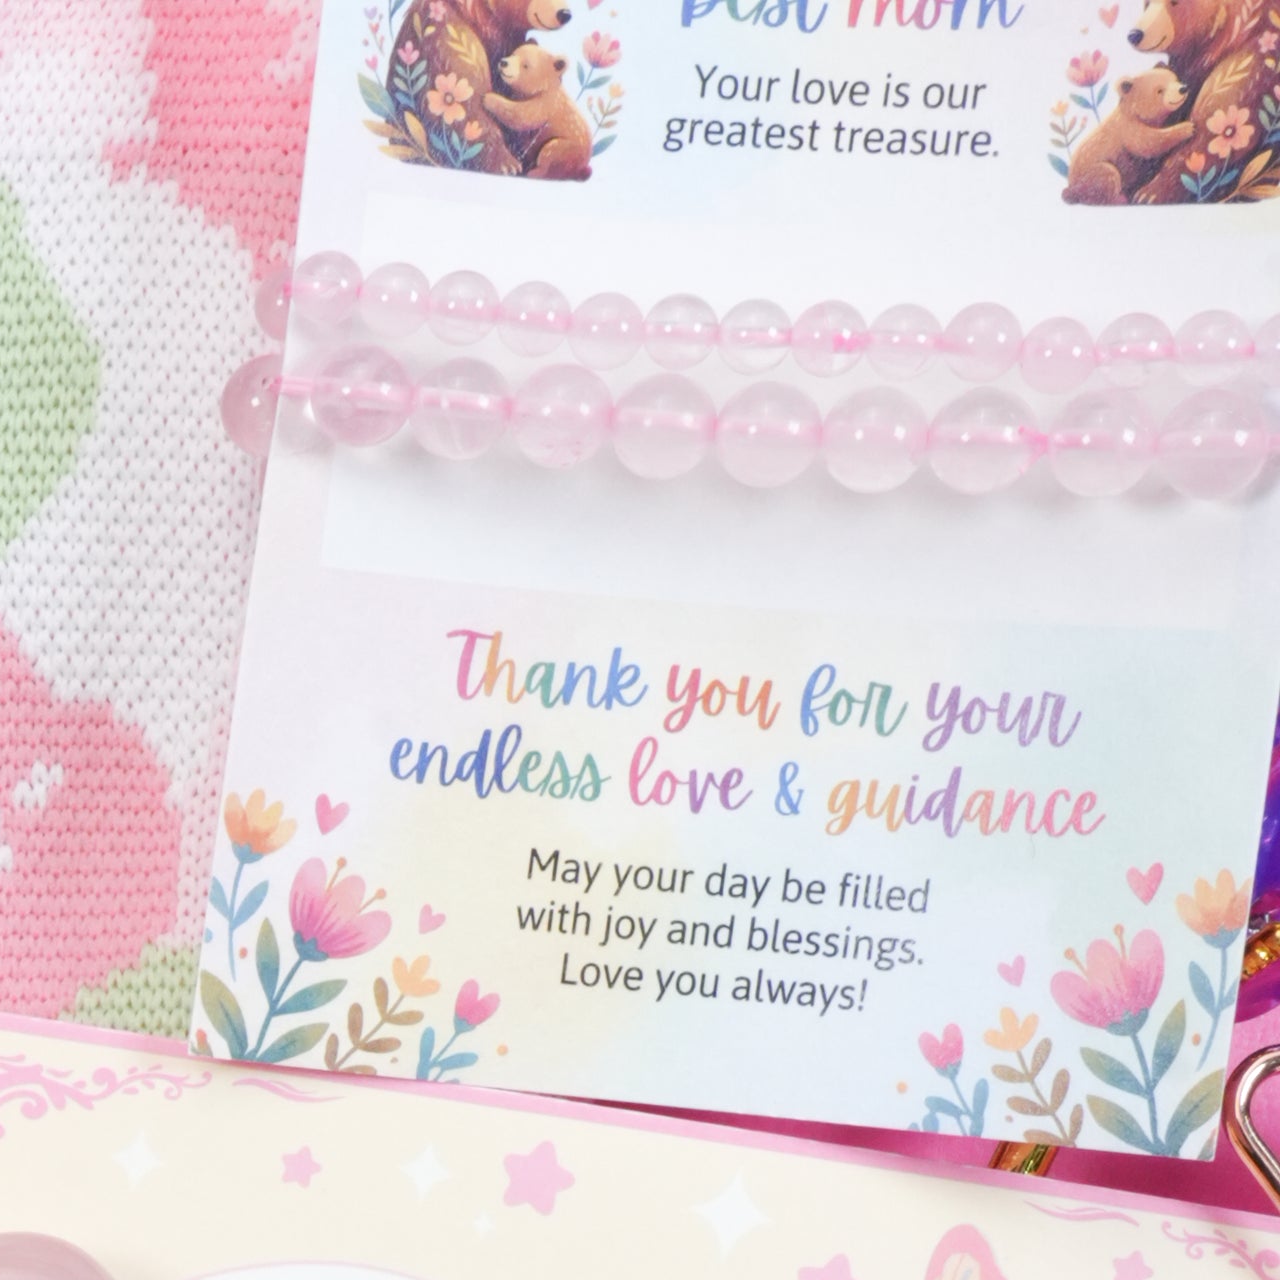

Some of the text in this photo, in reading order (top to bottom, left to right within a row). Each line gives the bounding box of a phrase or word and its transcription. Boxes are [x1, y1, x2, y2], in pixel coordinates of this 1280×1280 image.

[694, 63, 988, 111] Your love is our
[662, 113, 1001, 158] greatest treasure.
[446, 629, 1083, 752] Thank you for your
[389, 723, 1107, 838] endless love & guidance
[527, 848, 931, 915] May your day be filled
[516, 903, 925, 972] with joy and blessings.
[560, 953, 869, 1018] Love you always!
